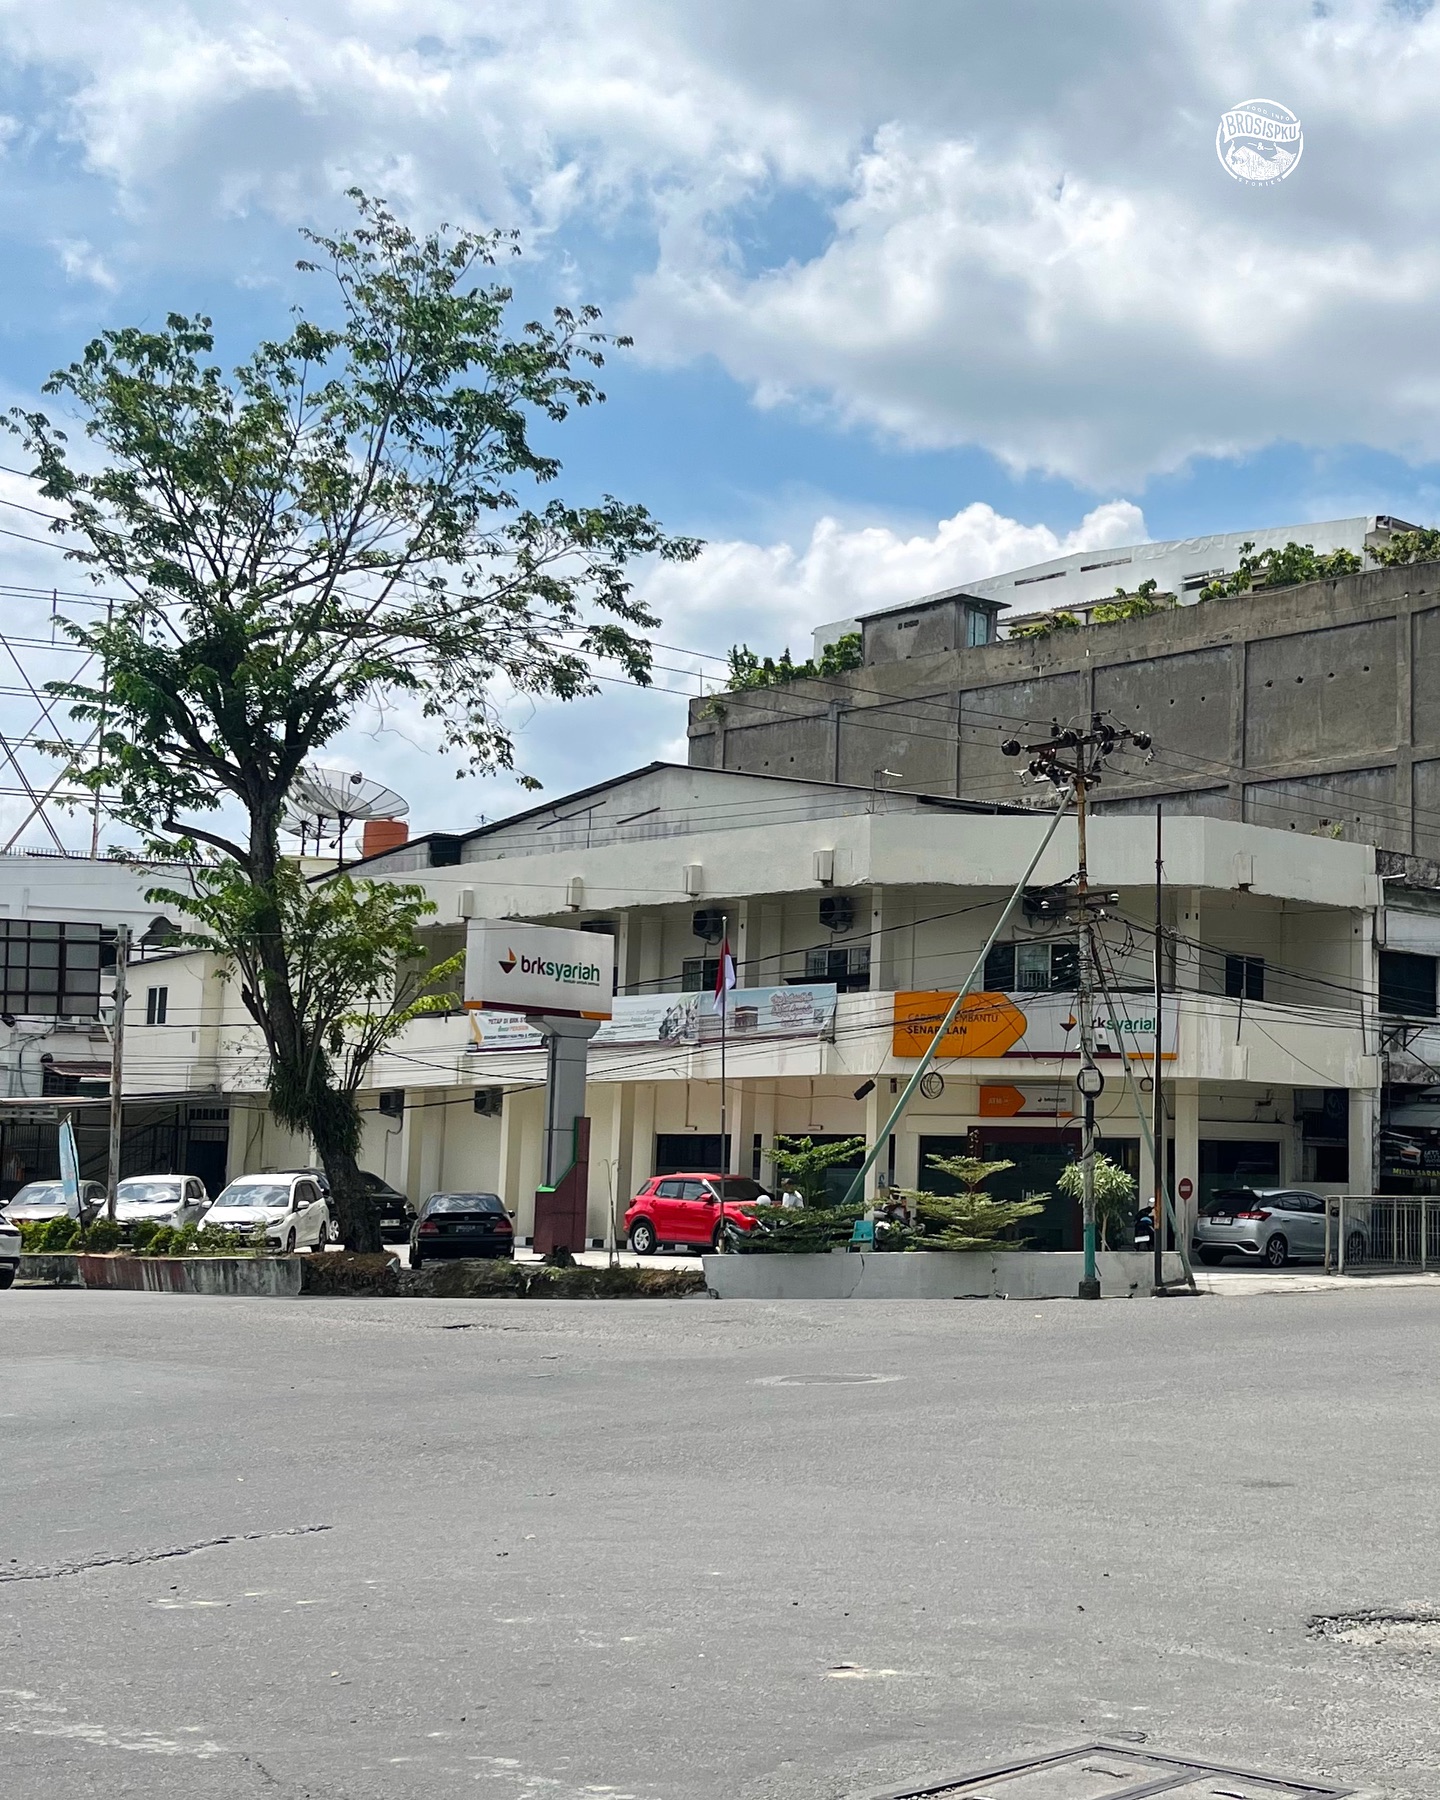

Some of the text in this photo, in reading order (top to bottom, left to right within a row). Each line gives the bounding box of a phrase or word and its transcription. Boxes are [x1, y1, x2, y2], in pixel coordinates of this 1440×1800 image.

[521, 955, 600, 982] brksyariah
[954, 1013, 998, 1022] EMBANTU
[1092, 1016, 1156, 1031] rksyaria
[907, 1025, 967, 1035] SENAPLAN
